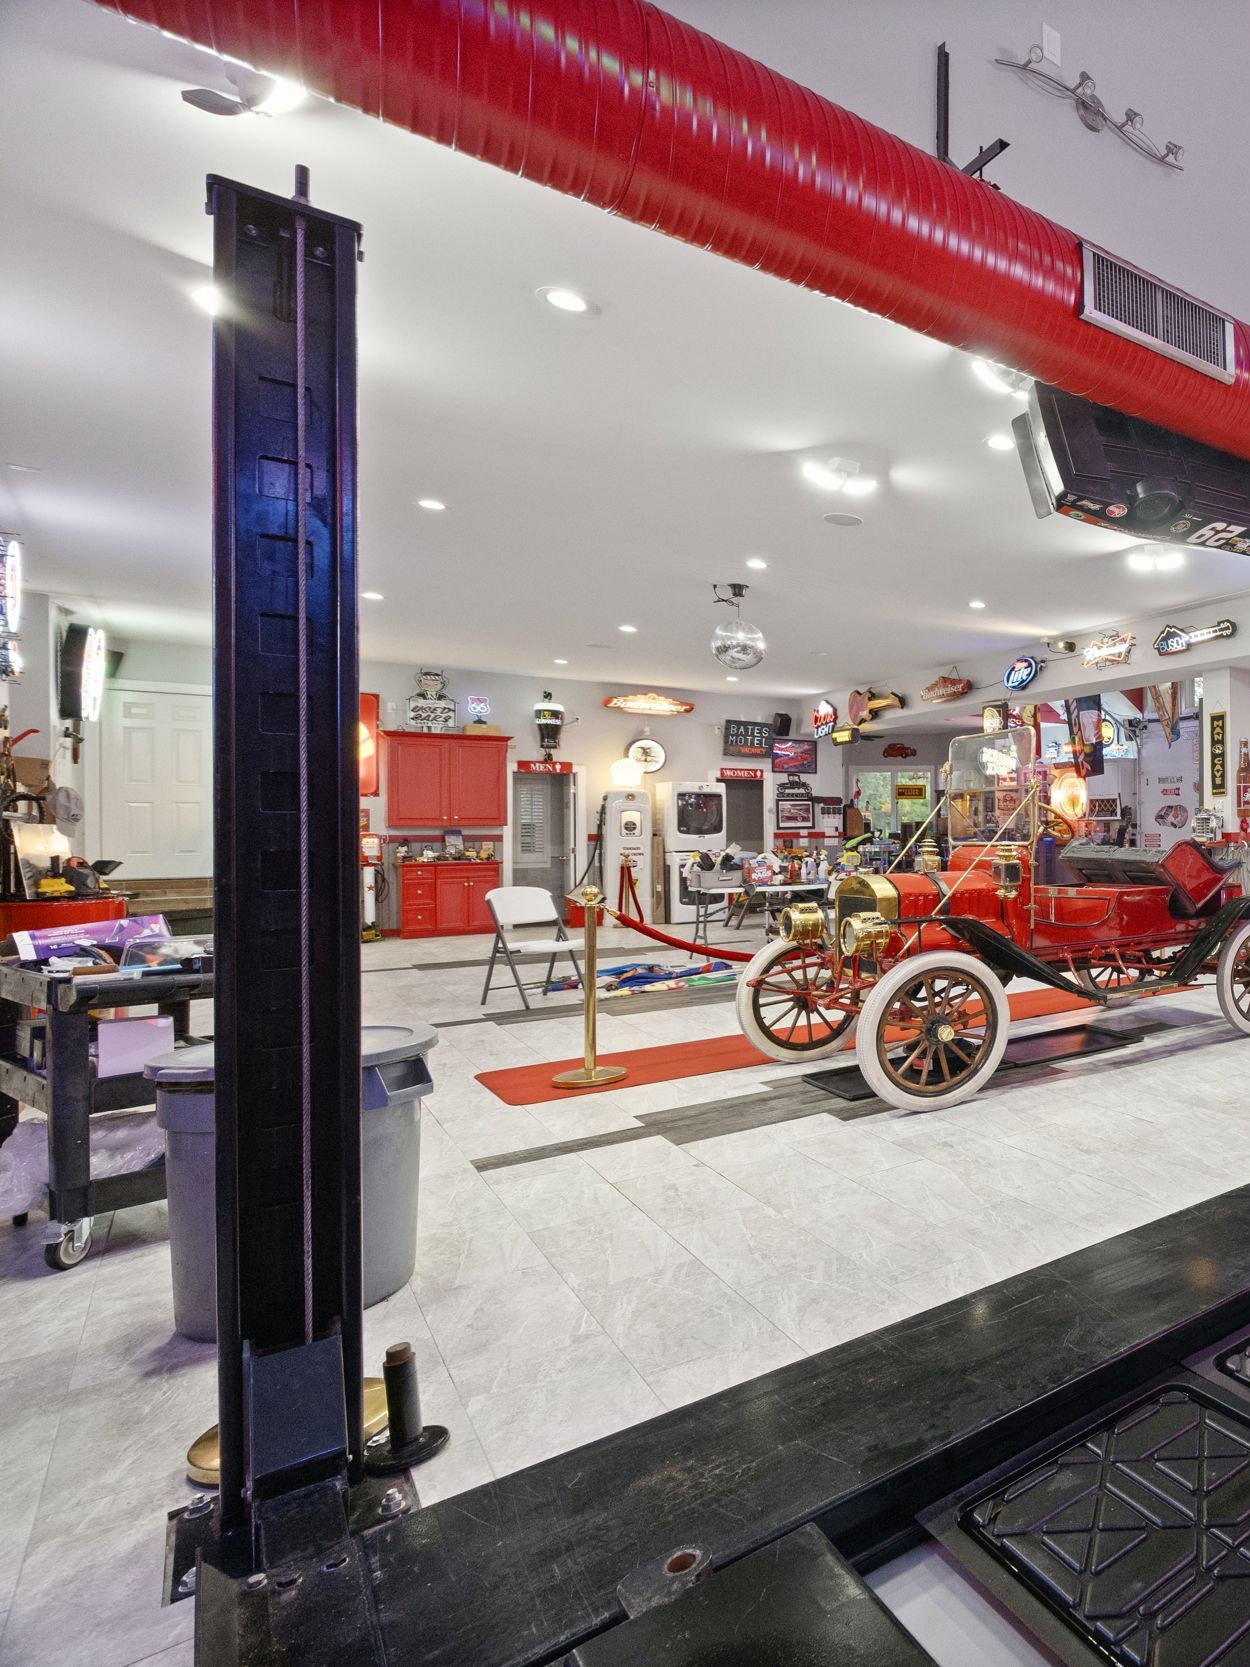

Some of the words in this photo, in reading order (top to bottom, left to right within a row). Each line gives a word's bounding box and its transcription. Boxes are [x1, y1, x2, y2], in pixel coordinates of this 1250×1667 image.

[1159, 638, 1186, 653] BUSCH
[1009, 669, 1030, 687] Lite
[410, 705, 456, 715] USED
[471, 703, 489, 712] 66
[811, 709, 835, 727] Coors
[730, 724, 770, 737] BATES
[814, 722, 834, 738] LIGHT
[1213, 720, 1223, 741] MAN
[728, 735, 769, 748] MOTEL
[741, 747, 767, 755] VACANCY
[530, 763, 552, 771] MEN
[722, 769, 755, 777] WOMEN
[1213, 758, 1223, 785] CAVE
